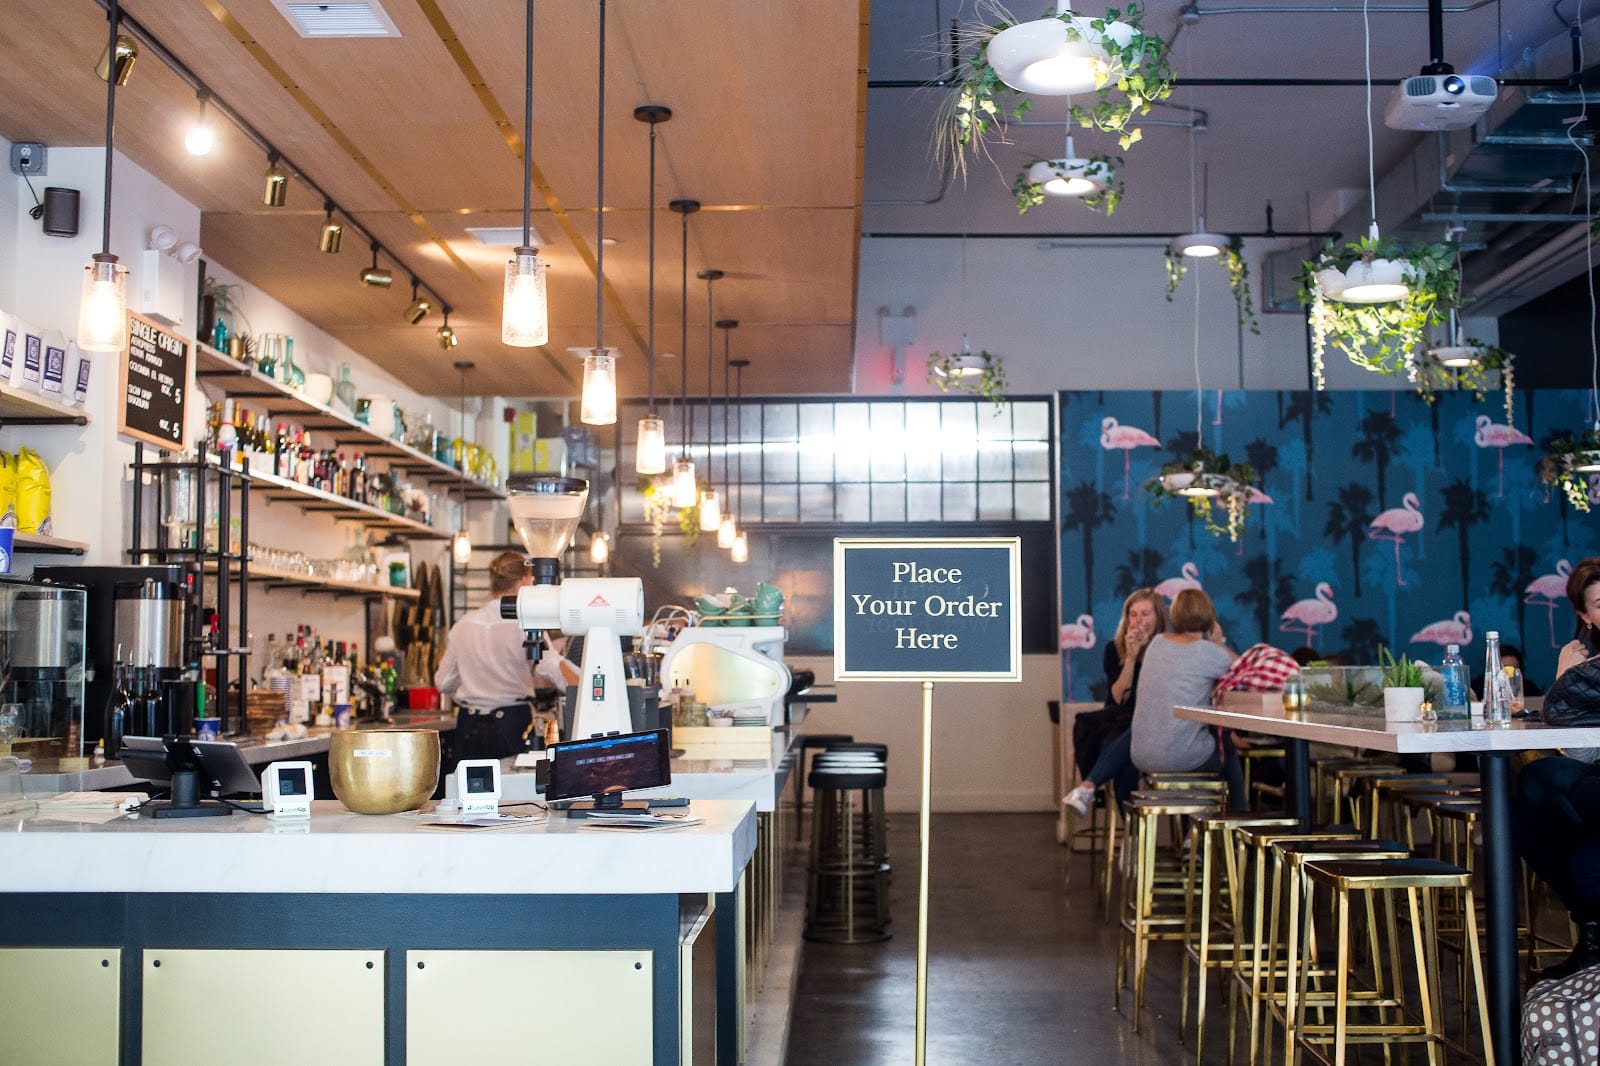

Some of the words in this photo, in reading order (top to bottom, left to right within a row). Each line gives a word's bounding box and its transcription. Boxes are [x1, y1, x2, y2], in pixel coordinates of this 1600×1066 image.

[130, 318, 157, 345] SINGLE
[157, 332, 183, 357] ORIGIN
[174, 388, 181, 404] 5
[173, 422, 180, 439] 5
[892, 561, 963, 584] Place
[851, 594, 917, 616] Your
[924, 595, 1003, 617] Order
[895, 627, 959, 650] Here
